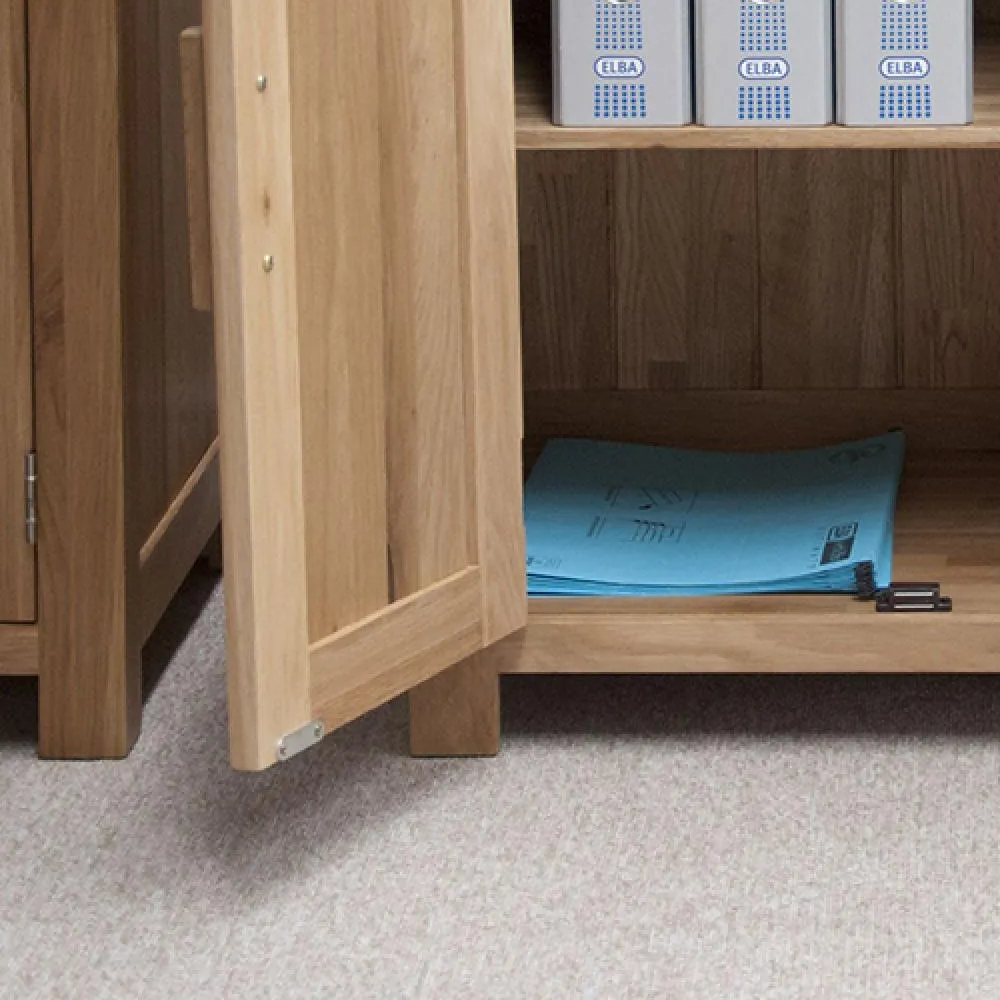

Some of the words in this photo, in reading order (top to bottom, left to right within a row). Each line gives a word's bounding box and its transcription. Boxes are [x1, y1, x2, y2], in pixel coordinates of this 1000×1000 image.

[601, 61, 638, 74] ELBA
[745, 62, 782, 75] ELBA
[886, 61, 923, 74] ELBA
